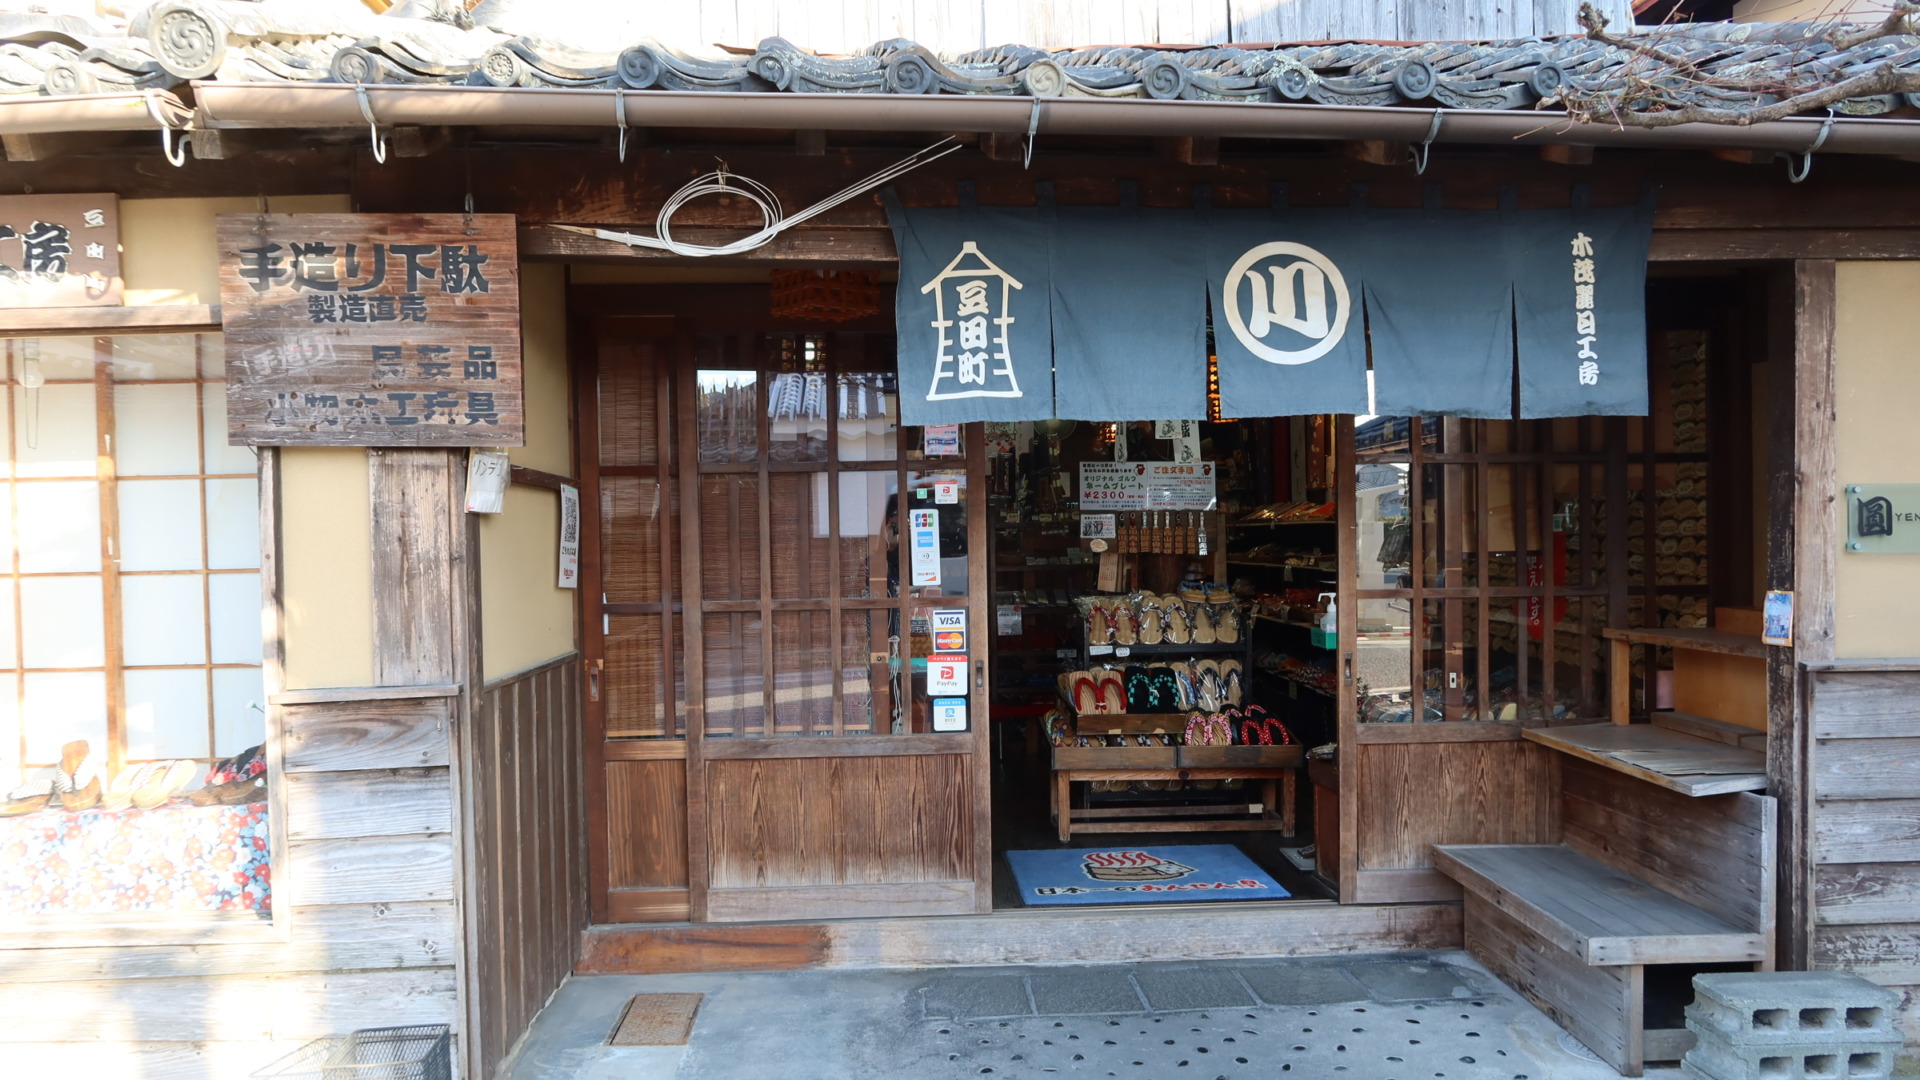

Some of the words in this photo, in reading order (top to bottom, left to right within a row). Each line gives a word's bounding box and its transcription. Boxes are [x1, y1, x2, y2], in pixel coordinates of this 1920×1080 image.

[238, 241, 489, 294] 手造り下駄
[307, 294, 428, 323] 製造直売
[955, 279, 989, 387] 豆田町
[1086, 482, 1144, 490] ネームプレート
[939, 617, 961, 625] VISA
[1036, 879, 1266, 895] 日本一のおんせん県
